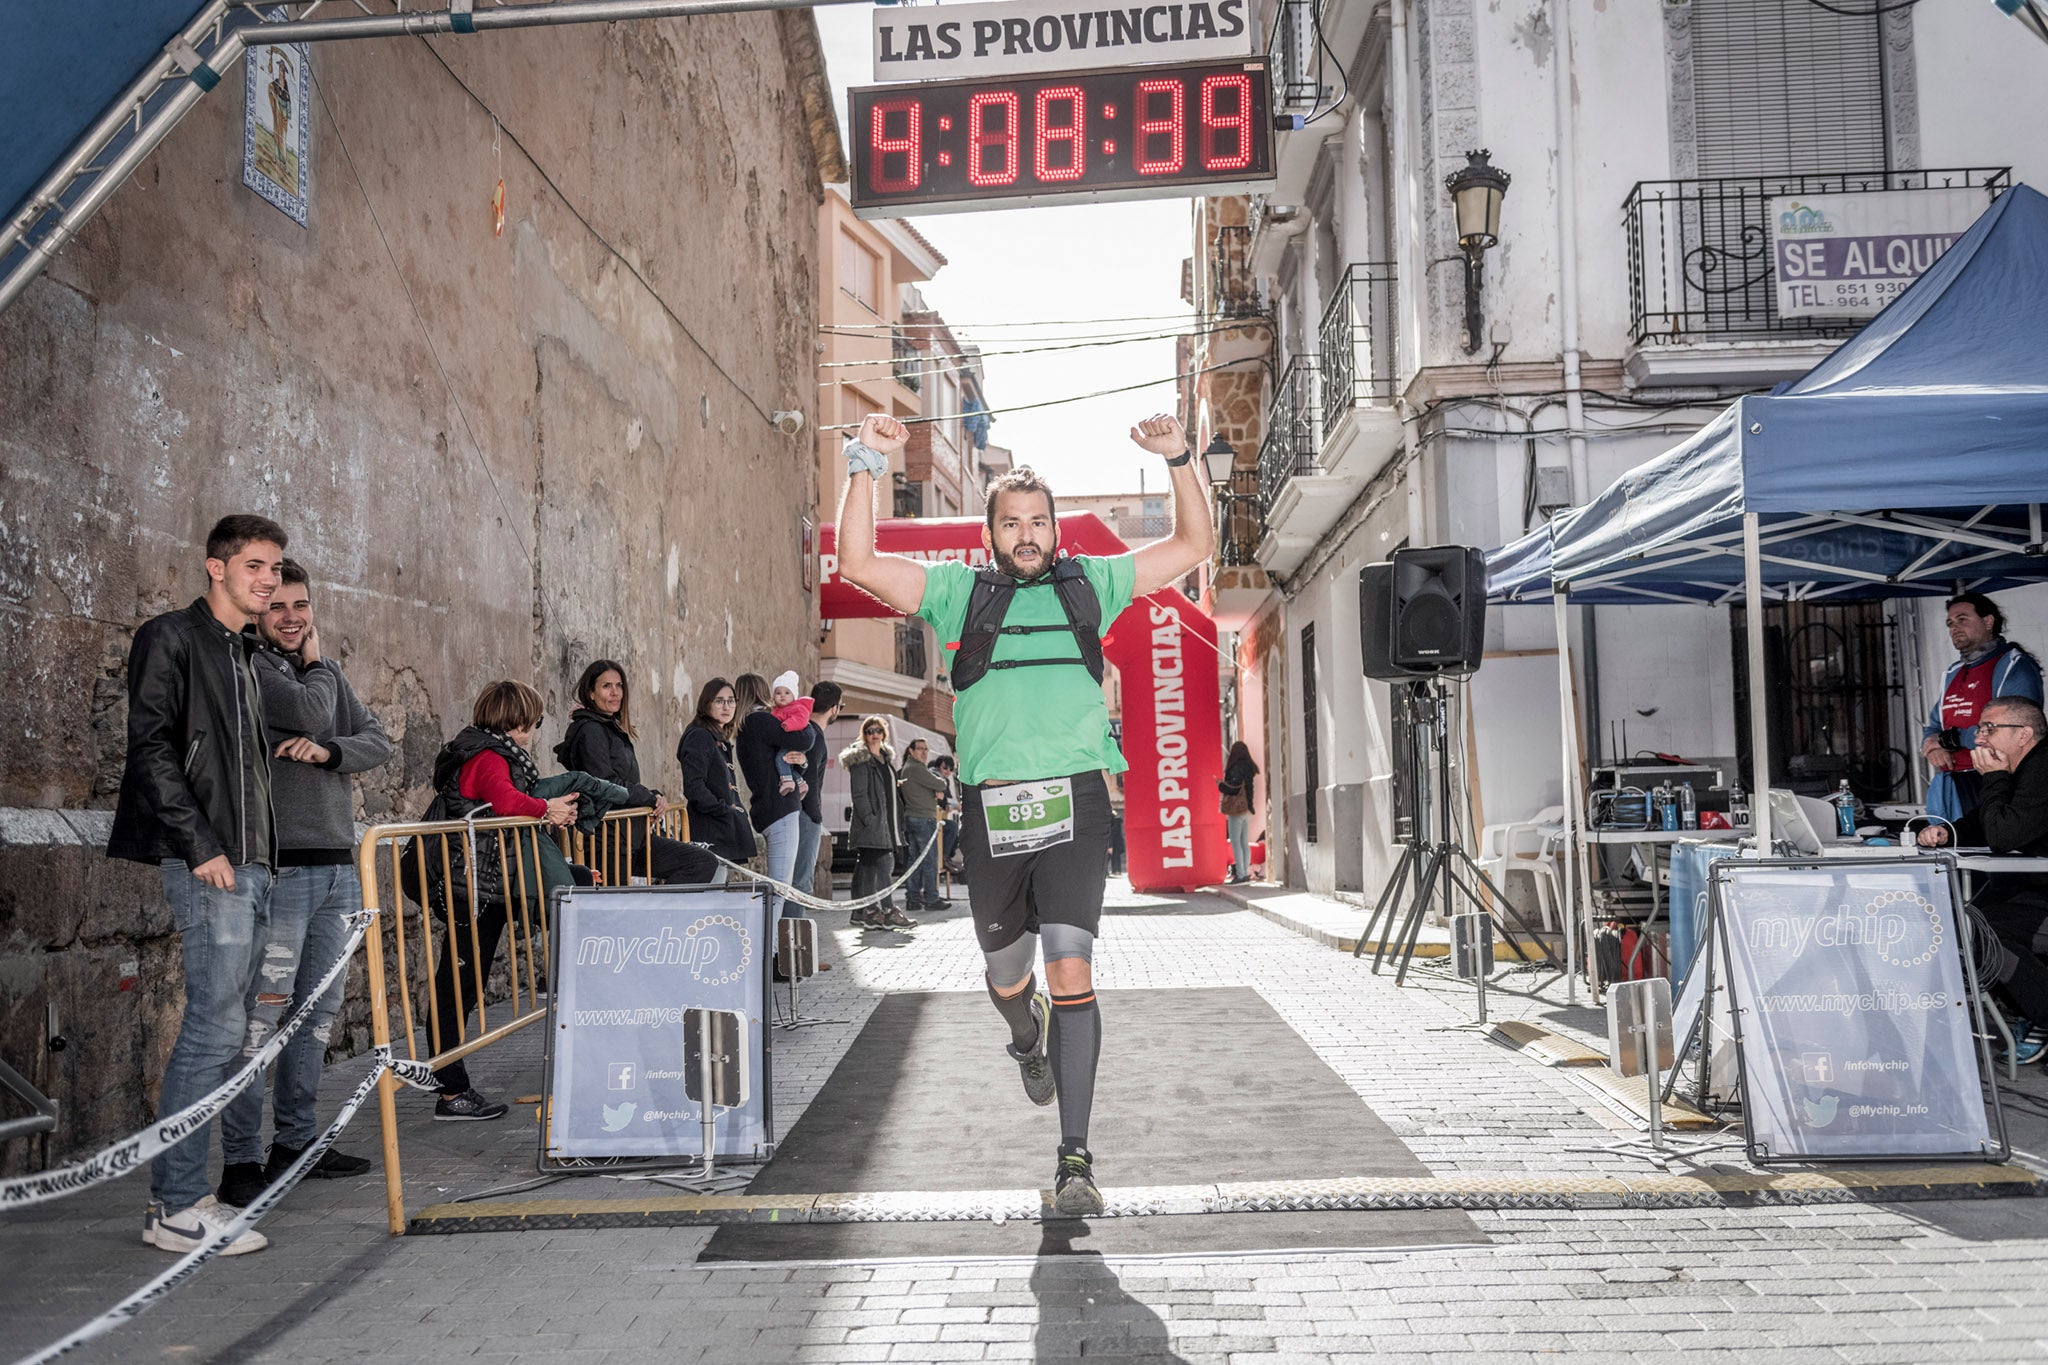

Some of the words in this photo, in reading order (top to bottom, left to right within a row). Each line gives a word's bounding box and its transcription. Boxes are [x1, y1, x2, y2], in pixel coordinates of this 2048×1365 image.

[880, 22, 962, 63] LAS
[972, 0, 1244, 58] PROVINCIAS
[1784, 242, 1827, 277] SE
[1836, 282, 1867, 295] 651
[1838, 296, 1870, 308] 964
[1149, 606, 1190, 801] PROVINCIAS
[1008, 802, 1046, 823] 893
[1160, 806, 1193, 868] LAS
[1750, 904, 1906, 957] mychip
[577, 926, 720, 974] mychip
[1756, 990, 1948, 1016] www.mychip.es
[1843, 1060, 1909, 1072] /infomychip
[1848, 1104, 1929, 1118] @Mychip_Info
